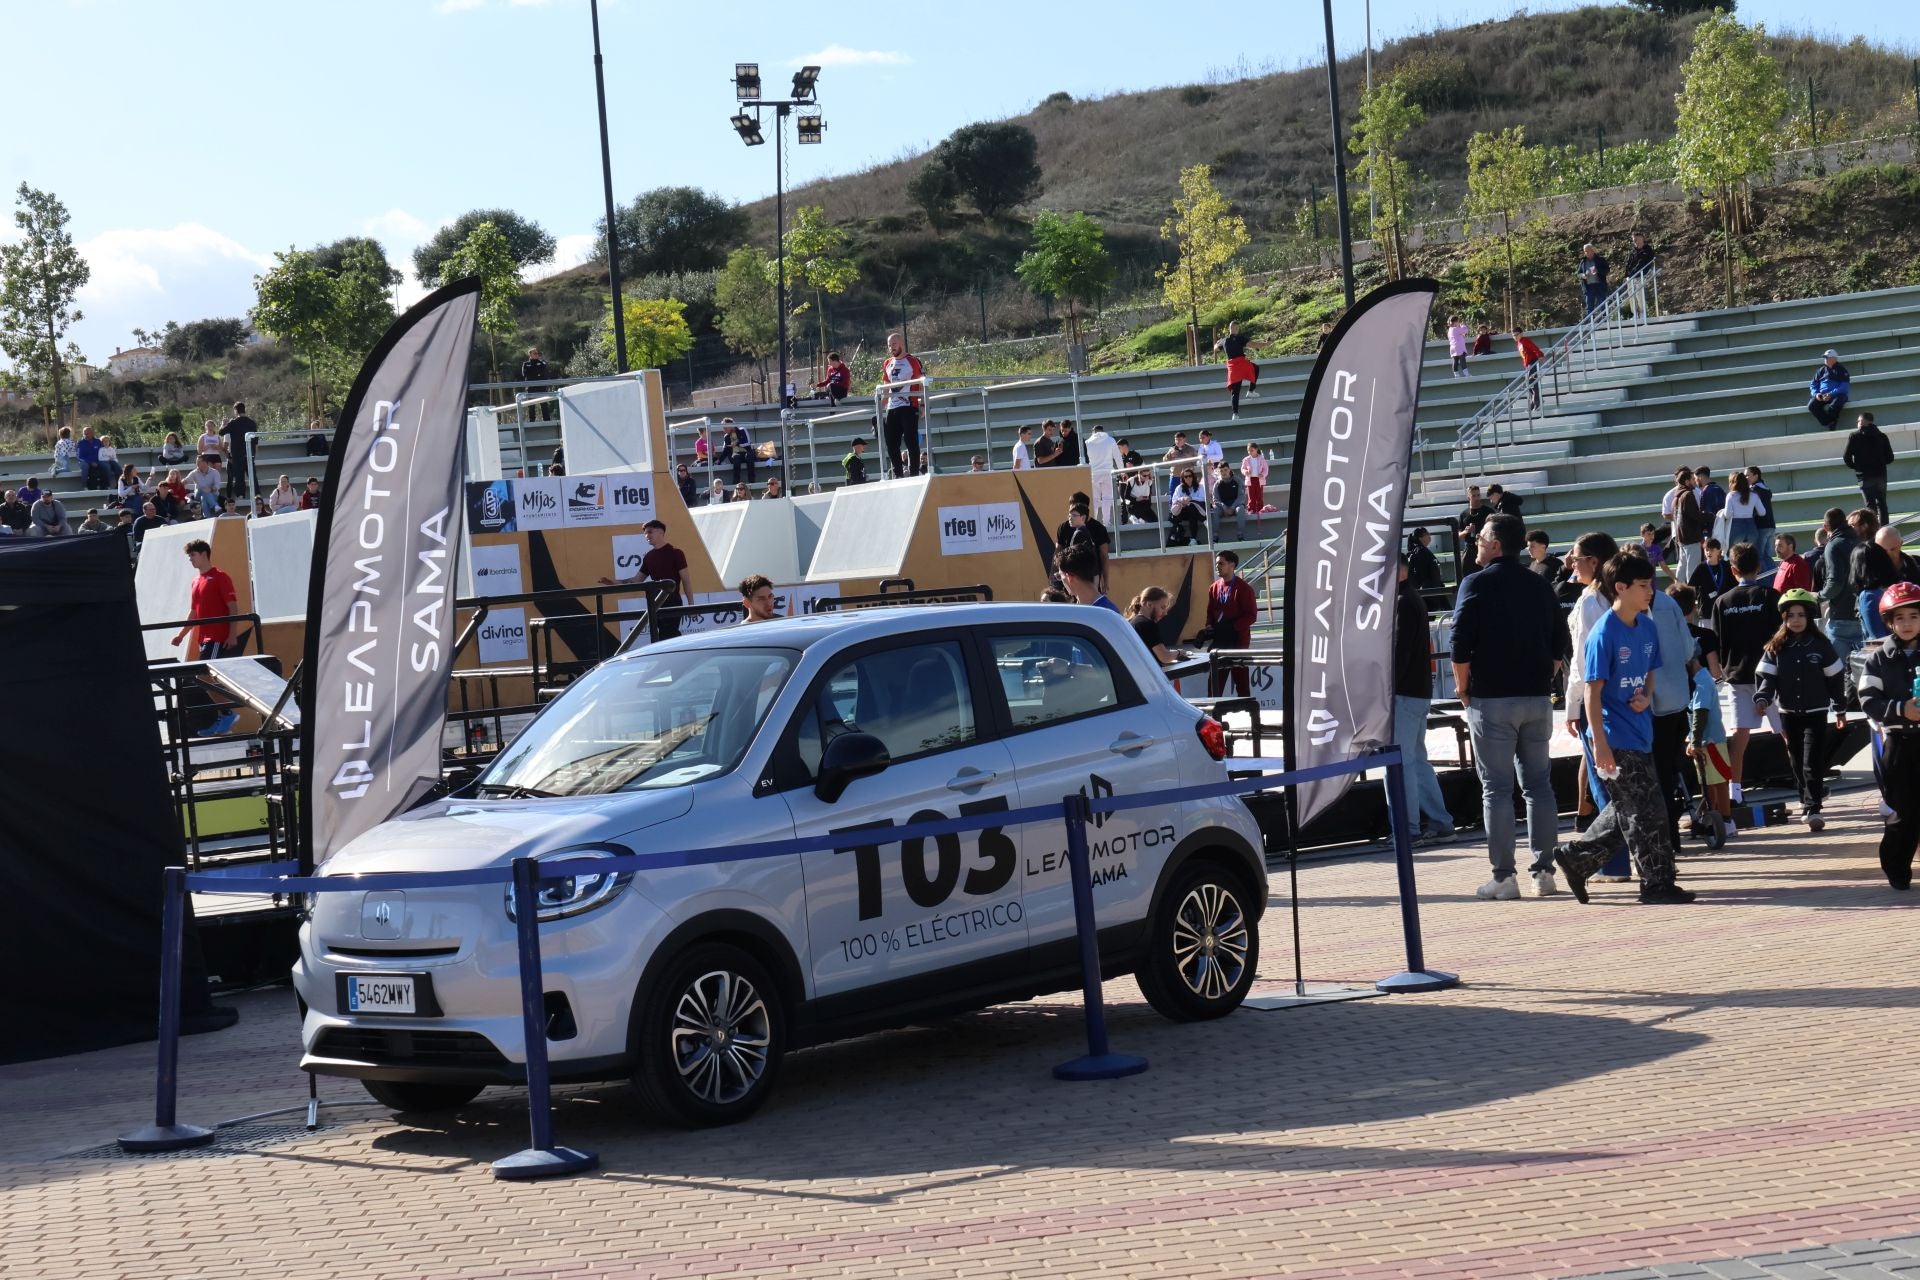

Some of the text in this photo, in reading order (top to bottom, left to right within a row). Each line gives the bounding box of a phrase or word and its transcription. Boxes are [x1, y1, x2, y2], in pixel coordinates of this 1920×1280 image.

[522, 490, 557, 513] Mijas
[613, 485, 650, 506] rfeg
[944, 517, 977, 537] rfeg
[987, 514, 1016, 535] Mijas
[1310, 369, 1359, 699] LEAPMOTOR
[1355, 482, 1394, 631] SAMA
[342, 400, 402, 750] LEAPMOTOR
[411, 505, 449, 673] SAMA
[481, 624, 524, 641] divina
[761, 778, 773, 788] EV
[828, 795, 1017, 922] T03
[1026, 824, 1176, 877] LEAMOTOR
[1091, 861, 1129, 889] AMA
[840, 900, 1024, 963] 100 % ELÉCTRICO
[358, 983, 411, 1005] 5462MWY
